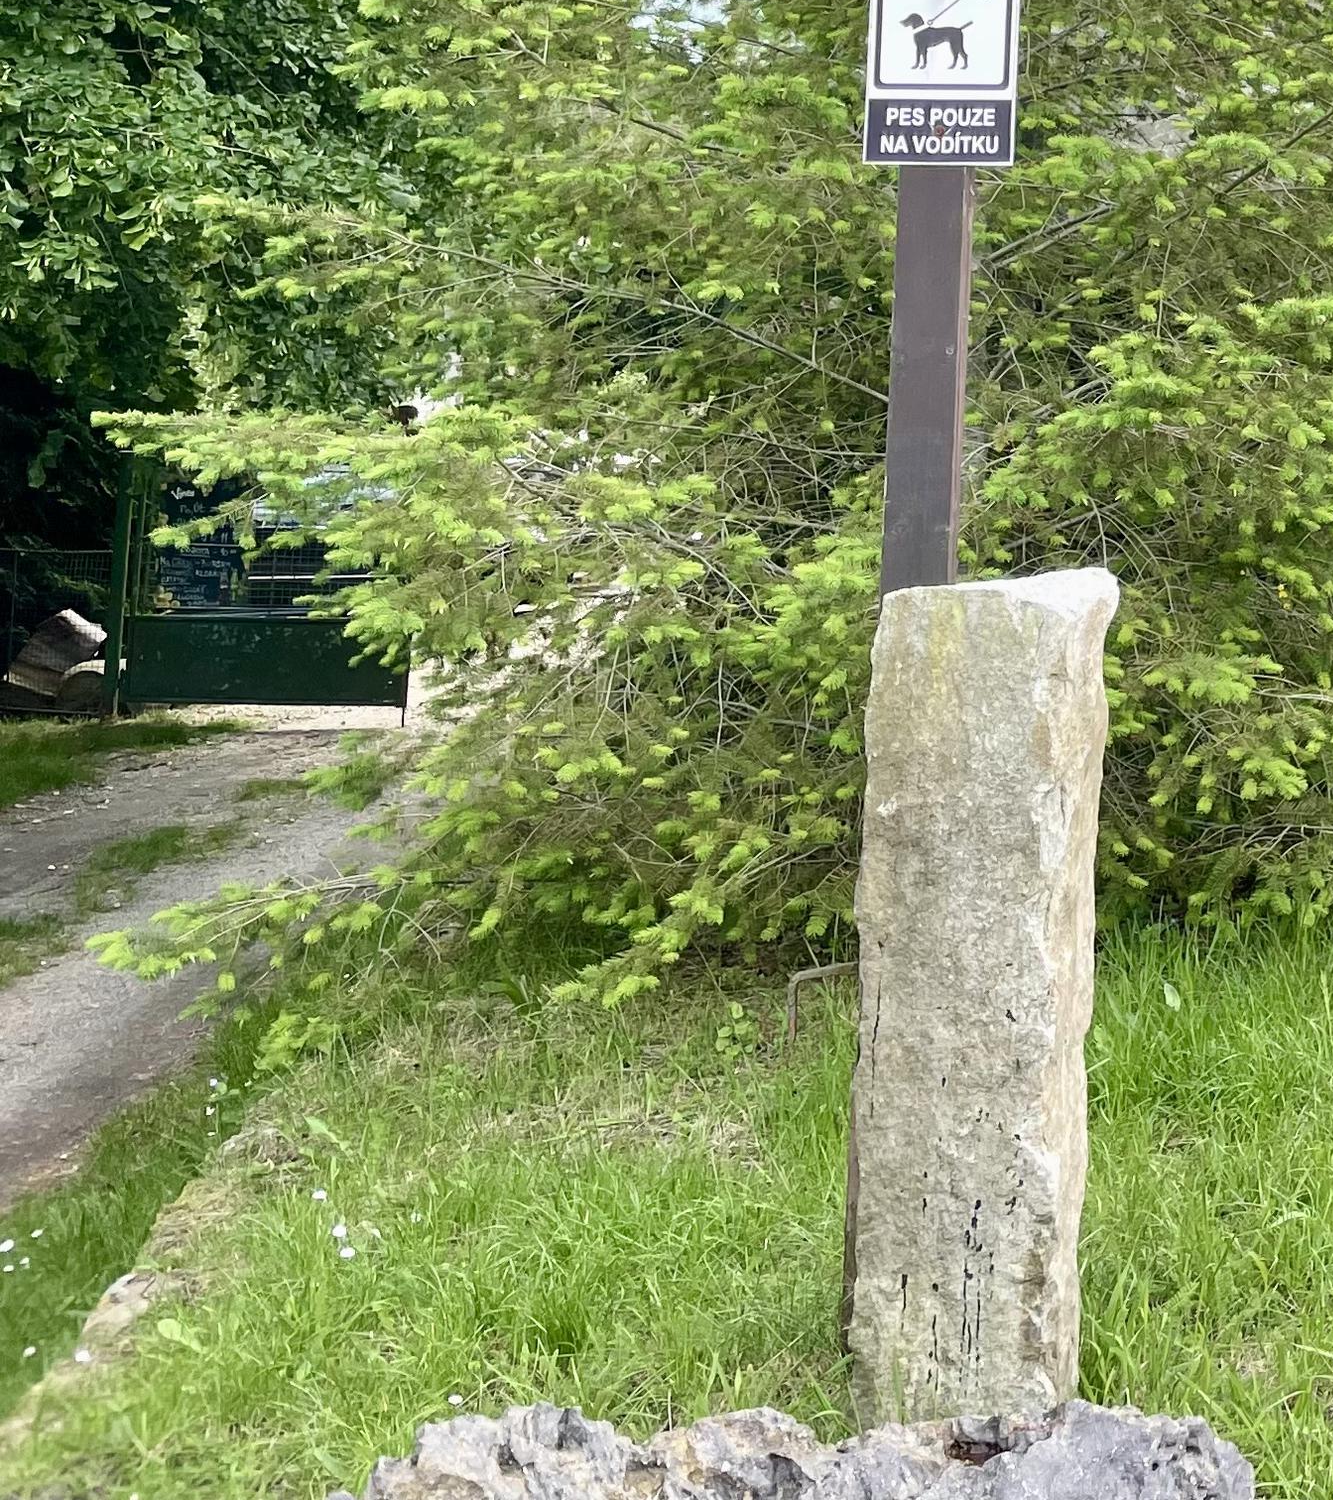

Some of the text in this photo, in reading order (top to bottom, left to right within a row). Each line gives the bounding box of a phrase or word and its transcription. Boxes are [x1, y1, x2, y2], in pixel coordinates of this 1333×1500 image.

[886, 107, 996, 127] PES POUZE
[880, 132, 999, 154] NA VODÍTKU
